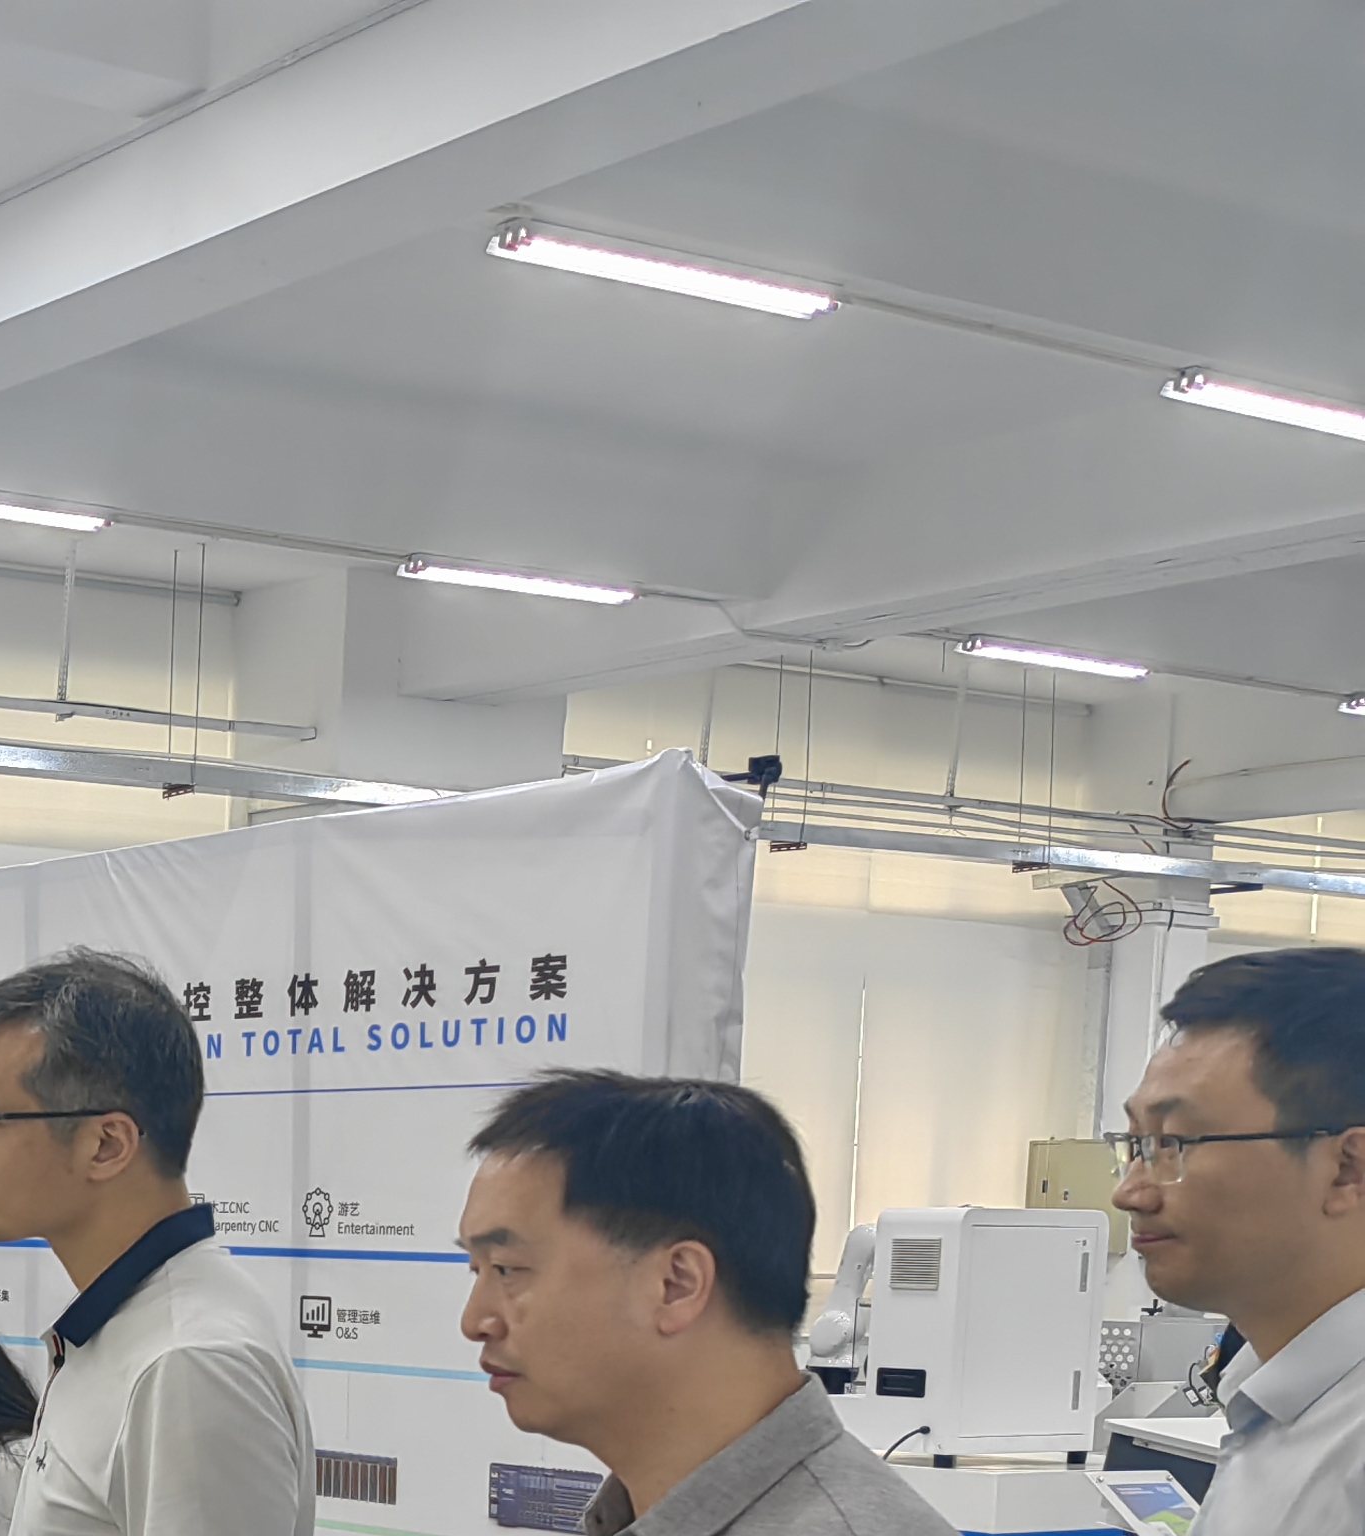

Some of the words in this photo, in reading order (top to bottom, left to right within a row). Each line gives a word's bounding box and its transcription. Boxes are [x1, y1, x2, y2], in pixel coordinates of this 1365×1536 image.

[242, 1026, 346, 1057] TOTAL
[367, 1013, 568, 1052] SOLUTION
[214, 1220, 257, 1236] arpentry
[258, 1220, 280, 1233] CNC
[337, 1221, 415, 1237] Entertainment
[335, 1326, 359, 1340] O&S
